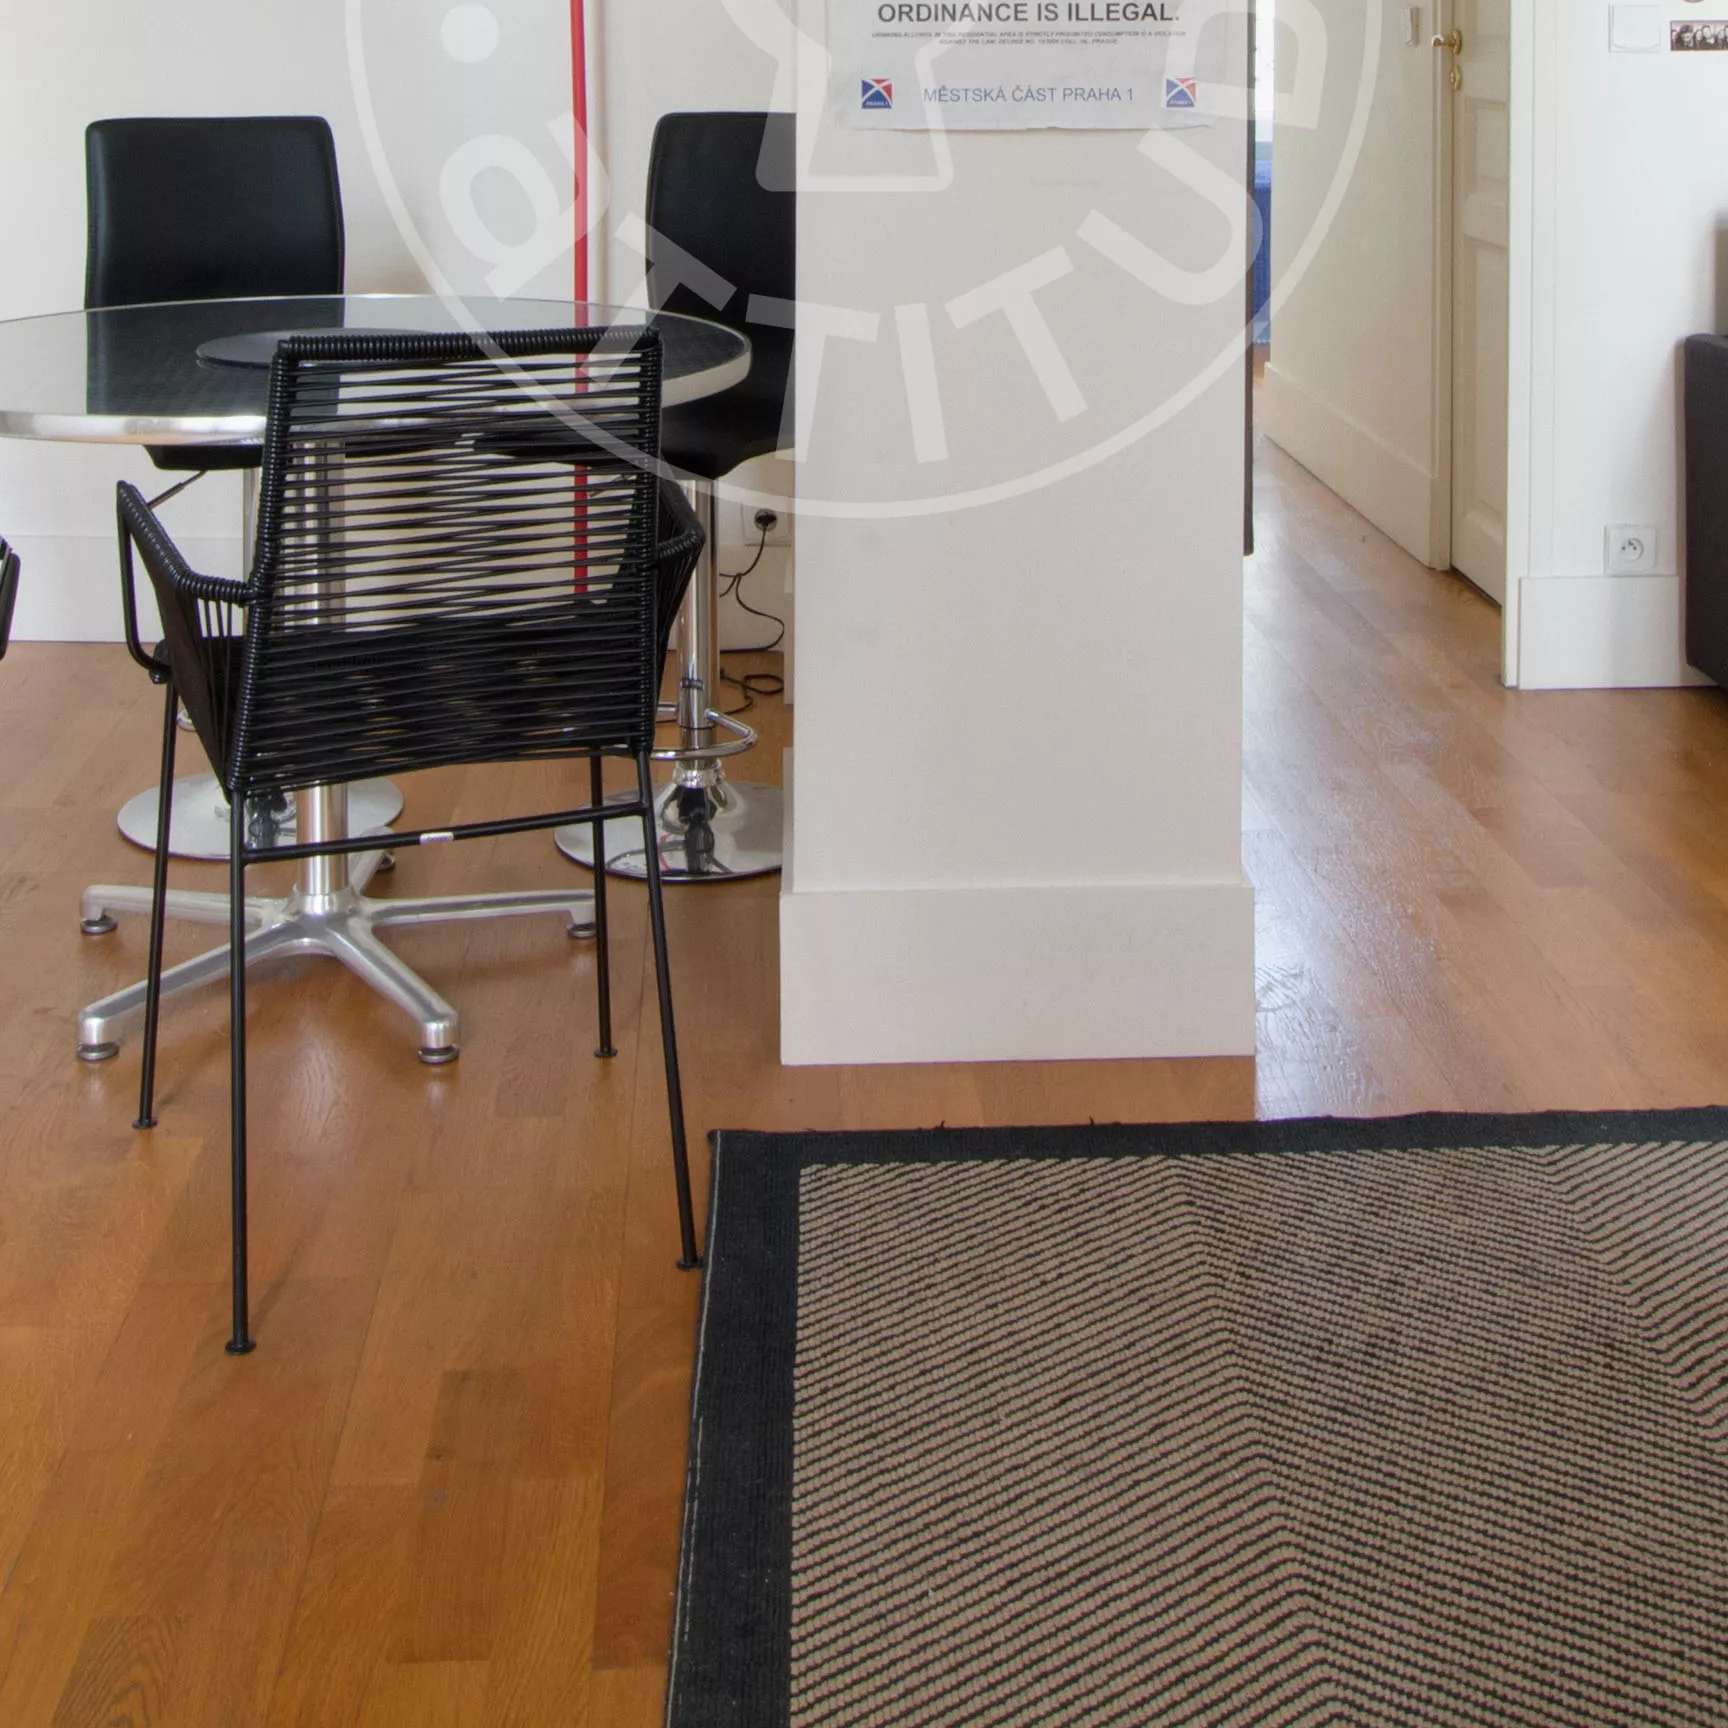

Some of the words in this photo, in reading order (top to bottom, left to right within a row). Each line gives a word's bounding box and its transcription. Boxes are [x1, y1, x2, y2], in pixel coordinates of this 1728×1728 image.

[877, 3, 1029, 23] ORDINANCE
[1037, 3, 1059, 23] IS
[1068, 3, 1179, 23] ILLEGAL.
[924, 84, 1005, 103] MĚSTSKÁ
[1011, 84, 1056, 103] ČÁST
[1063, 87, 1121, 102] PRAHA
[1127, 87, 1134, 101] 1
